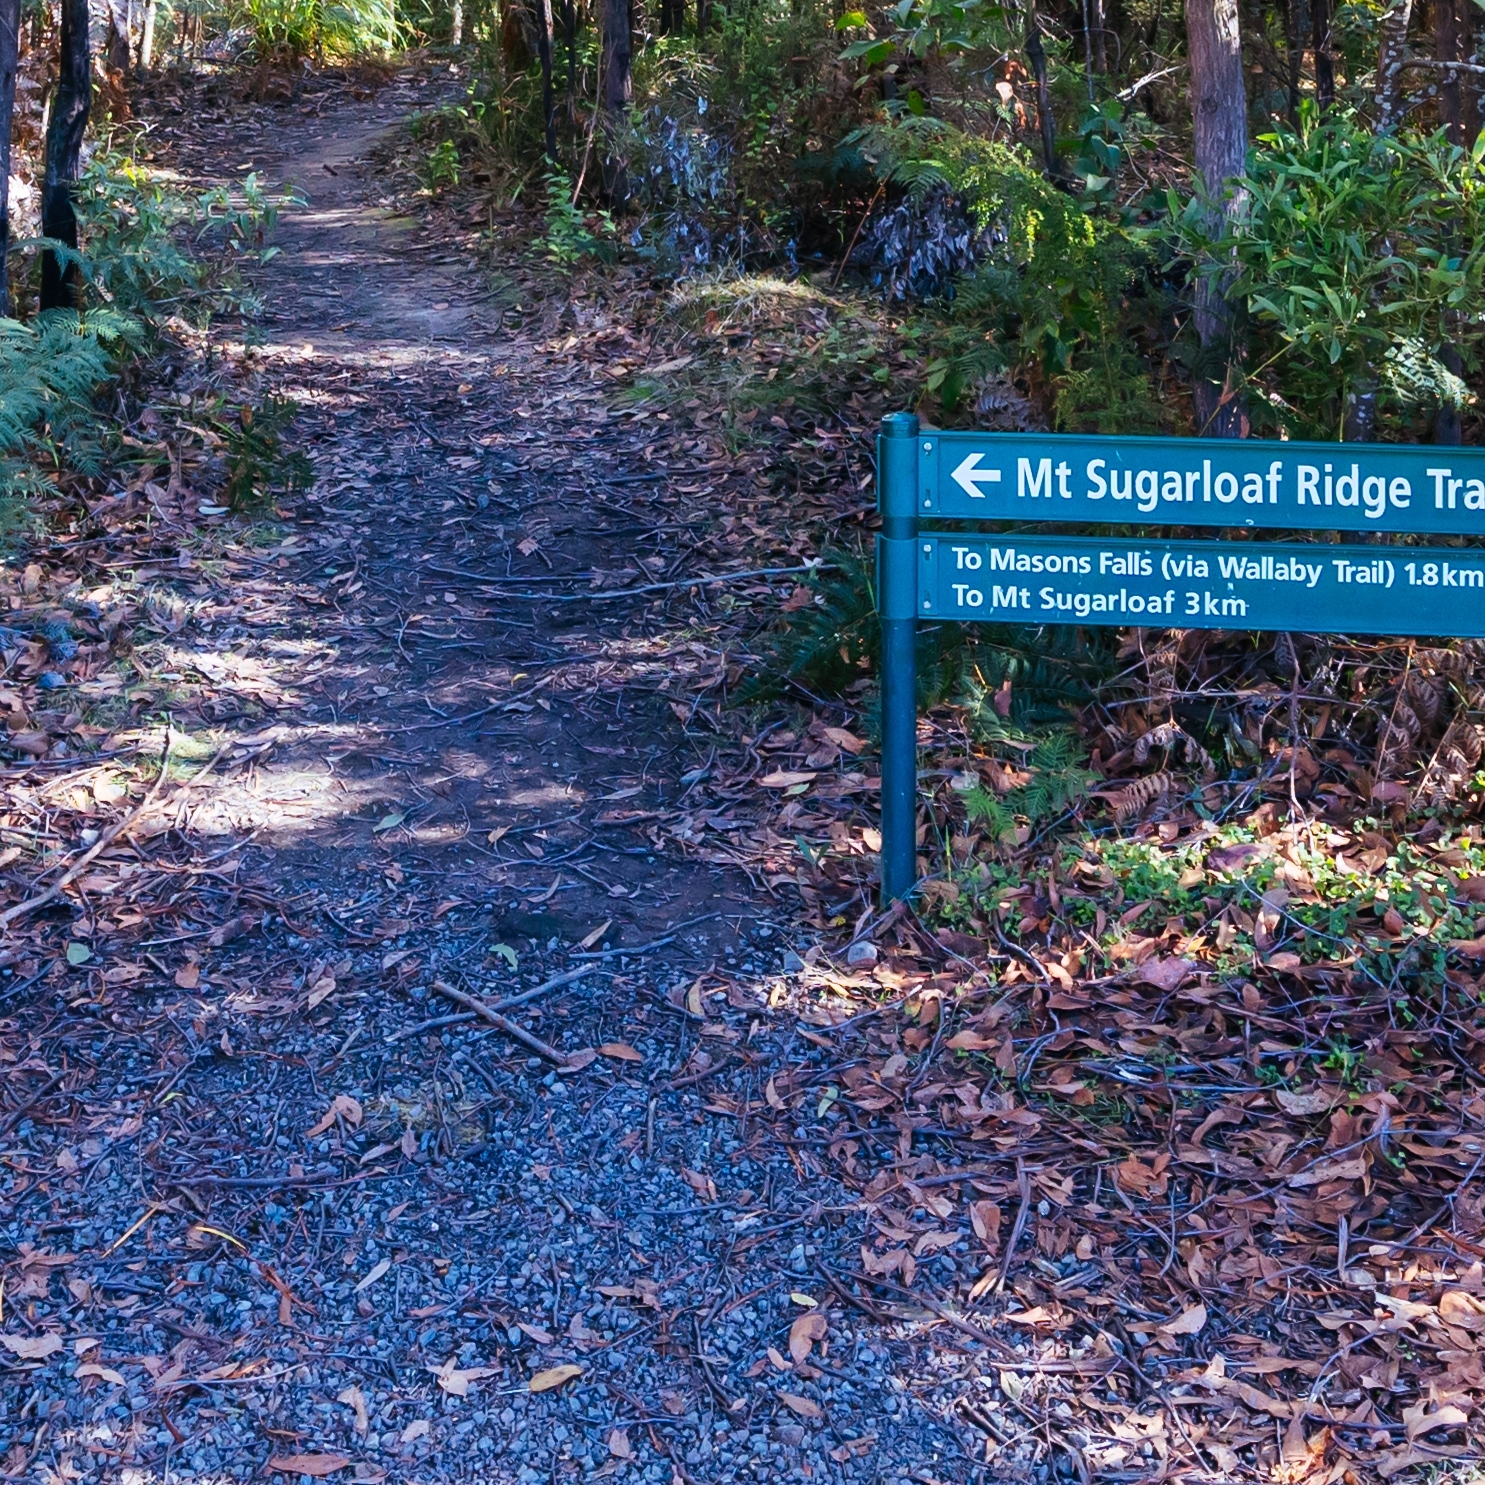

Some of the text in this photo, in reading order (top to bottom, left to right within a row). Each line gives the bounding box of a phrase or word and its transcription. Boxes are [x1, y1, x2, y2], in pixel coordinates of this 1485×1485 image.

[1017, 457, 1072, 499] Mt
[1086, 459, 1283, 512] Sugarloaf
[1297, 463, 1412, 519] Ridge
[951, 547, 982, 570] To
[990, 548, 1091, 575] Masons
[1099, 551, 1153, 576] Falls
[1161, 552, 1209, 581] (via
[1217, 555, 1323, 588] Wallaby
[1332, 559, 1396, 588] Trail)
[951, 583, 983, 608] To
[991, 585, 1031, 610] Mt
[1039, 587, 1175, 617] Sugarloaf
